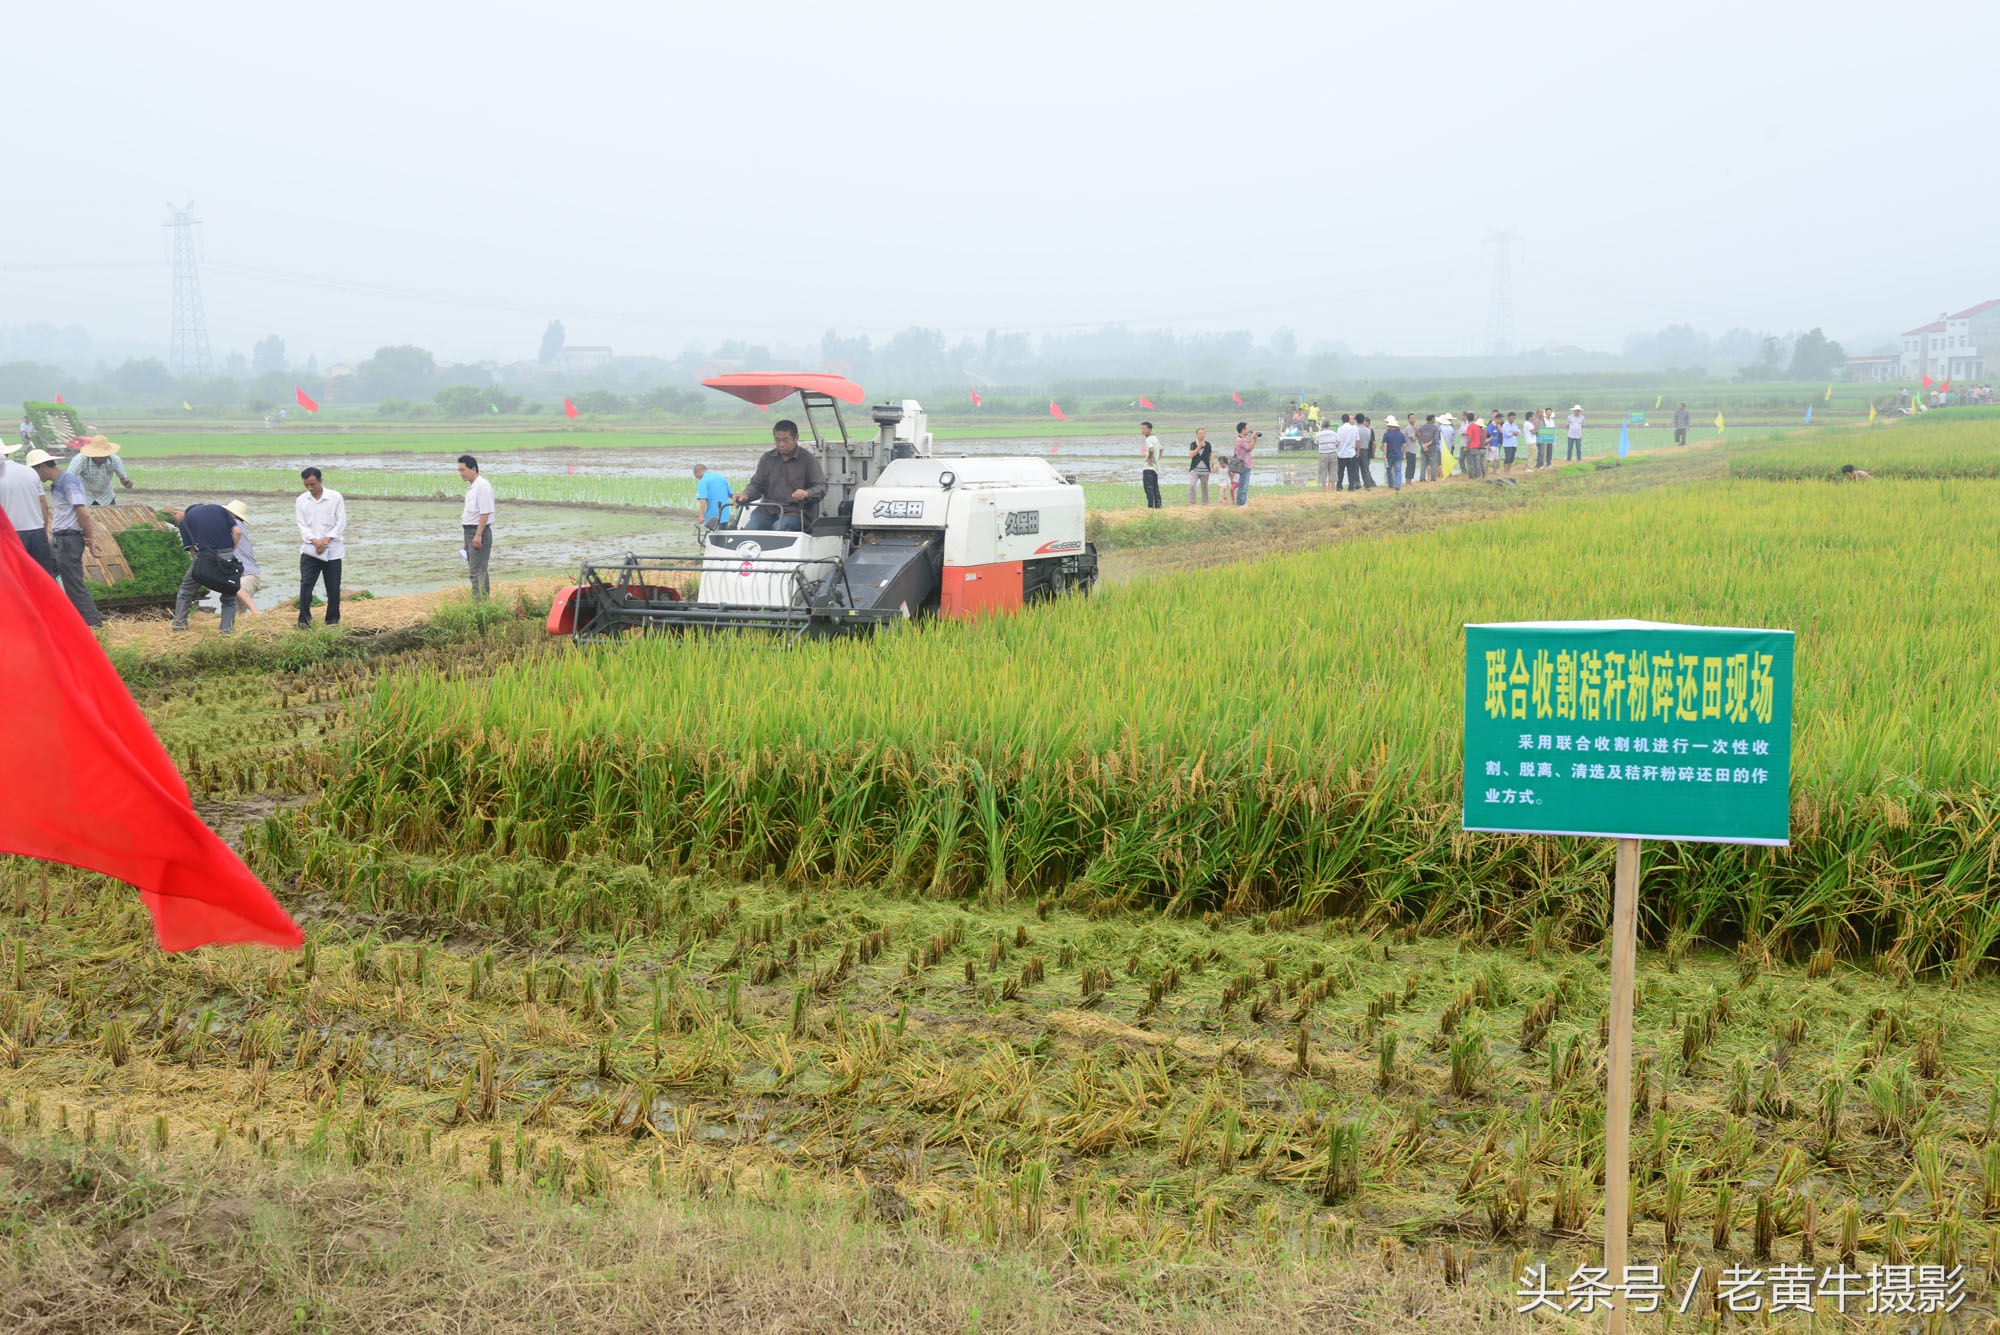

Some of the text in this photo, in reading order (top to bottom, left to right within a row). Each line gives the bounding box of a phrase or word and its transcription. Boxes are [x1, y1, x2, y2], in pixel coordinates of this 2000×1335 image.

[873, 500, 924, 519] 久保田
[1005, 510, 1040, 536] 久保田
[1485, 648, 1774, 724] 联合收割秸秆粉碎还田现场
[1518, 734, 1770, 756] 采用联合收割机进行一次性收
[1485, 760, 1769, 785] 割、脱离、清选及秸秆粉碎还田的作
[1485, 788, 1544, 806] 业方式。
